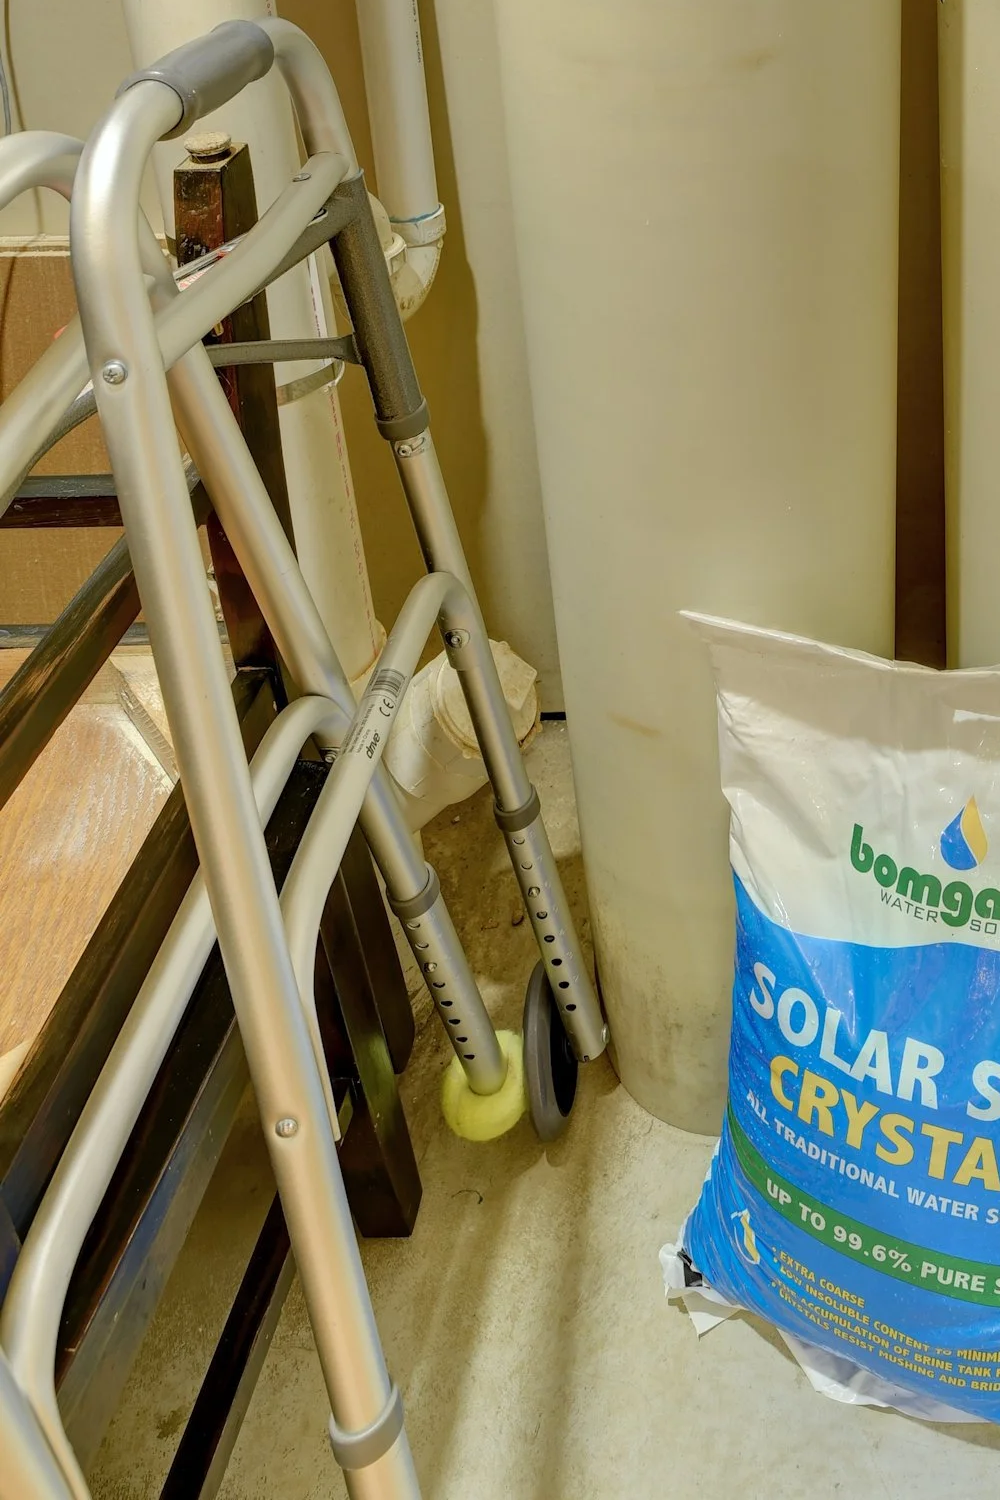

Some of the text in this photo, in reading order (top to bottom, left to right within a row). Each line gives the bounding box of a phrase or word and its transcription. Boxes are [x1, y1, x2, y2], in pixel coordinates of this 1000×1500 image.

[366, 732, 381, 759] drive
[880, 889, 939, 923] WATER
[749, 962, 945, 1109] SOLAR
[747, 1089, 770, 1125] ALL
[774, 1118, 899, 1199] TRADITIONAL
[906, 1186, 979, 1221] WATER
[766, 1178, 792, 1205] UP
[799, 1202, 826, 1231] TO
[833, 1225, 912, 1272] 99.6%
[920, 1261, 987, 1293] PURE
[780, 1251, 865, 1308] EXTRA COARSE
[779, 1288, 830, 1330] CRYSTALS
[833, 1328, 875, 1352] RESIST
[878, 1351, 935, 1379] MUSHING
[939, 1374, 966, 1388] AND
[780, 1266, 802, 1286] LOW
[806, 1285, 870, 1325] INSOLUBLE
[873, 1320, 930, 1352] CONTENT
[935, 1348, 952, 1356] TO
[801, 1298, 890, 1349] ACCUMULATION
[893, 1344, 910, 1356] OF
[914, 1353, 953, 1371] BRINE
[958, 1364, 991, 1378] TANK
